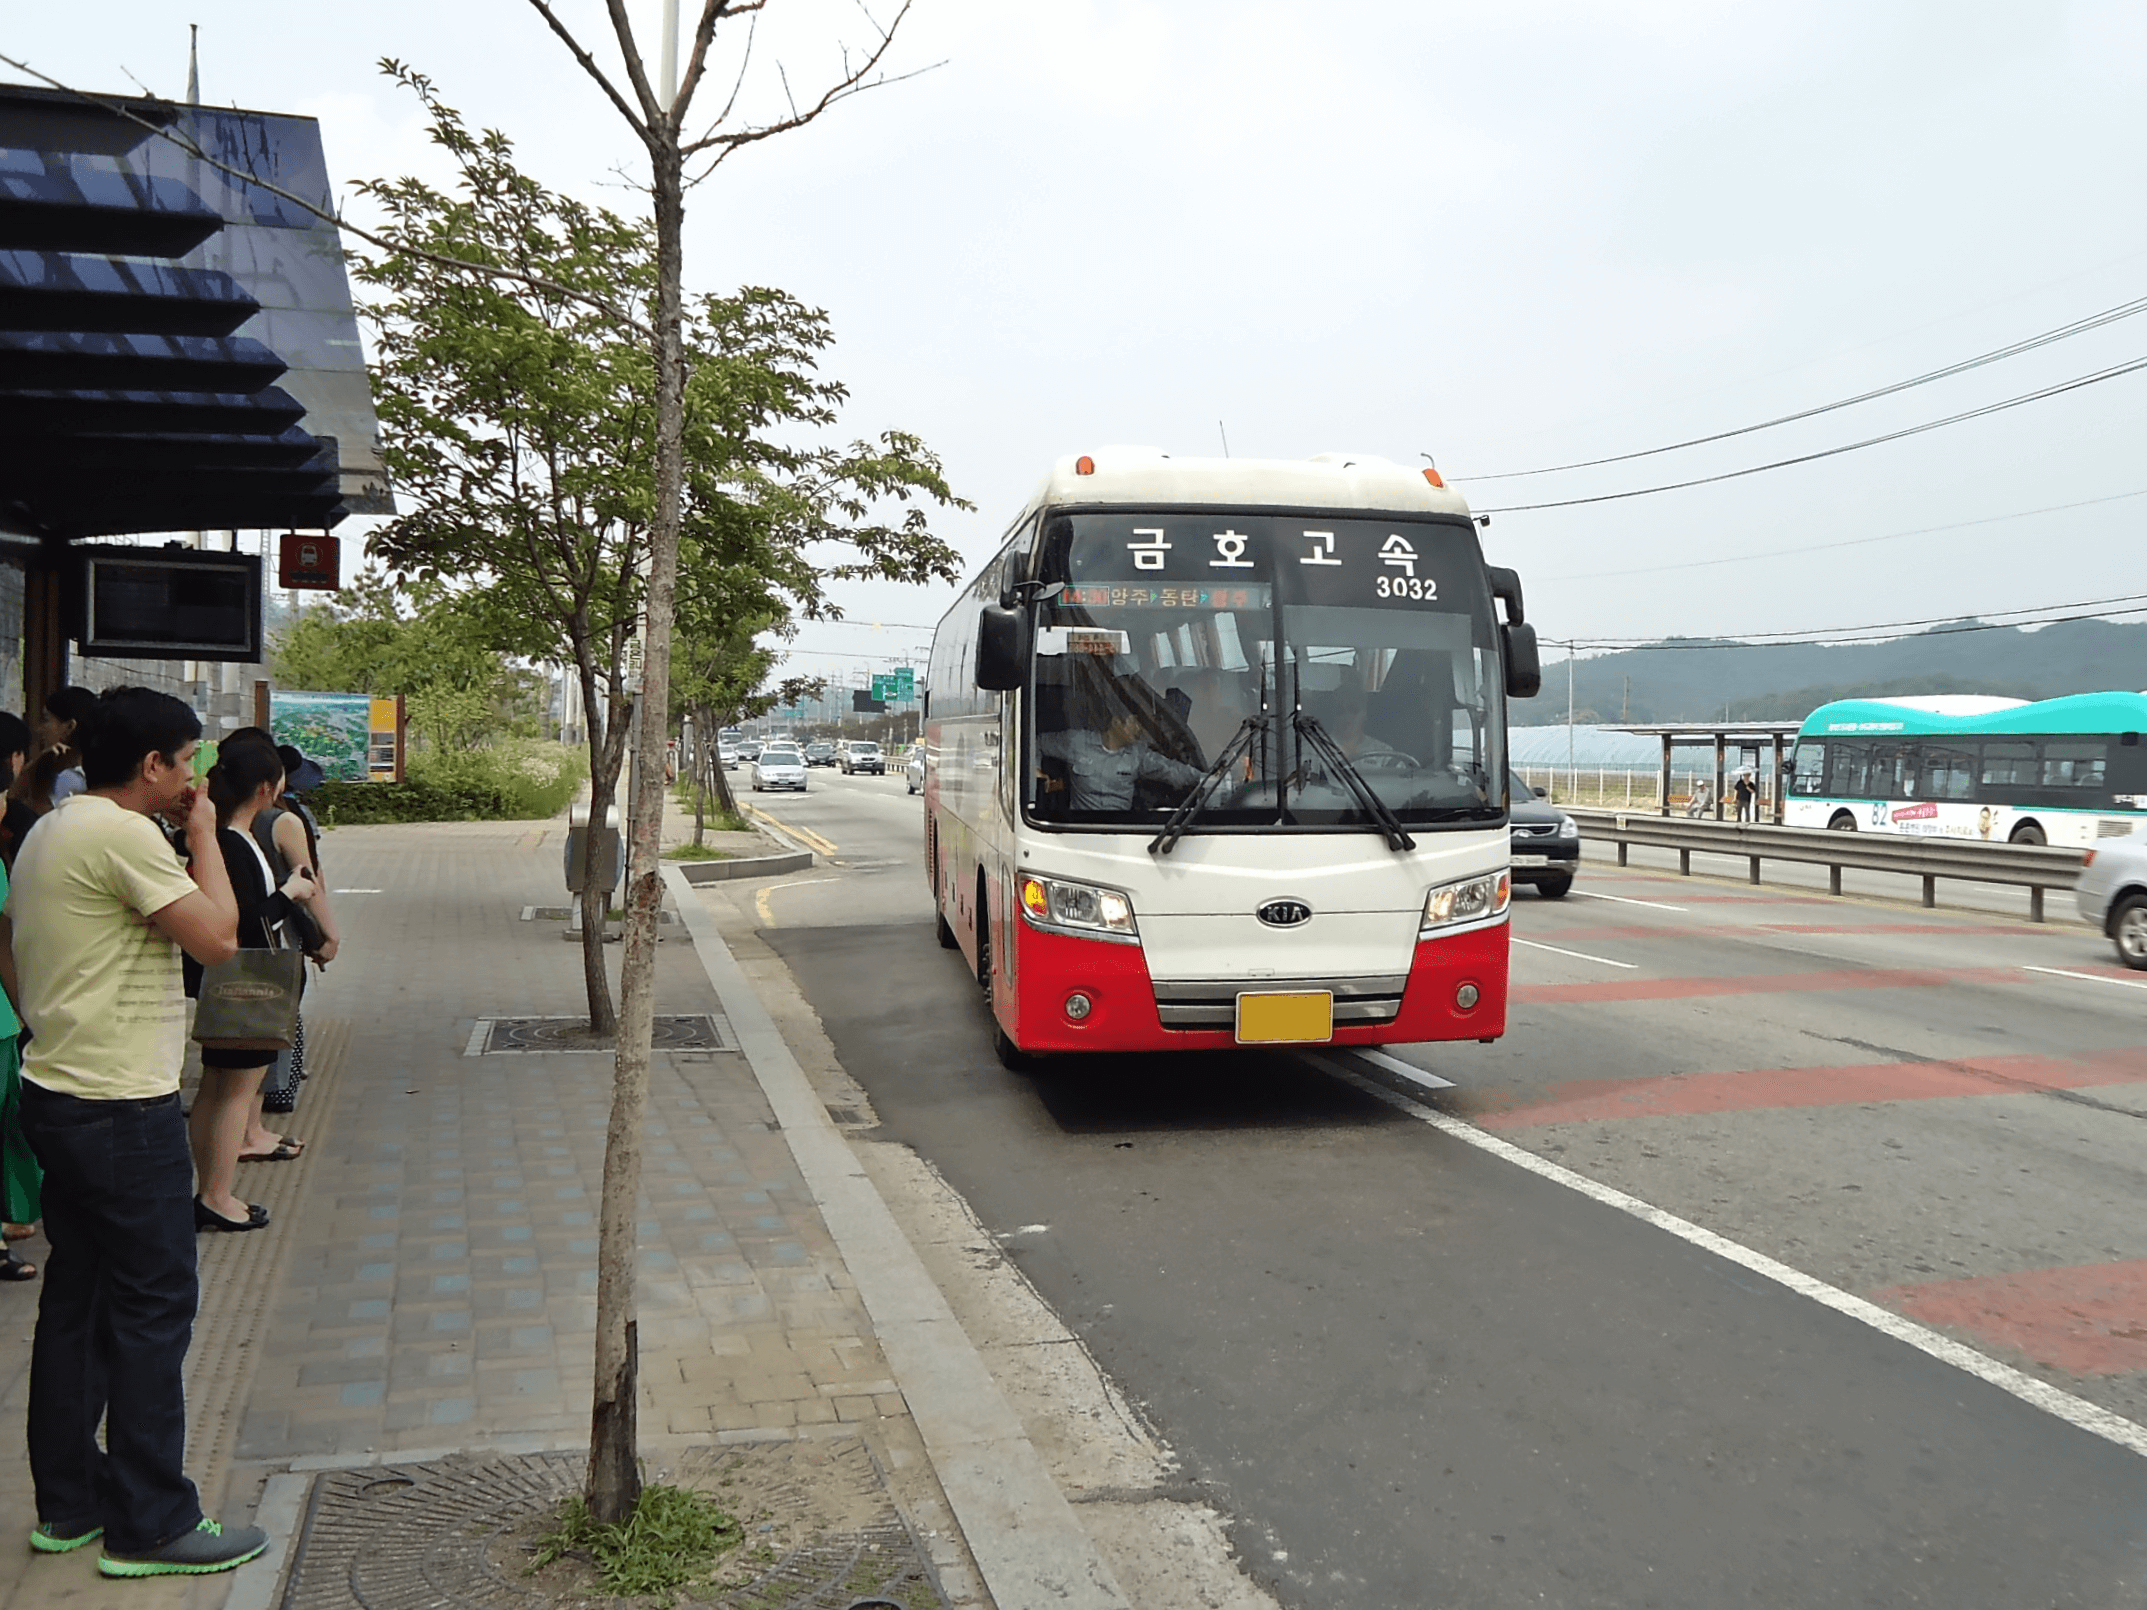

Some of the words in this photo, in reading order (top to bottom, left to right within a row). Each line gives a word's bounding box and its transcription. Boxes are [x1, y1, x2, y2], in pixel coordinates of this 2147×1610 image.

[1160, 588, 1198, 608] 동탄
[1376, 576, 1438, 601] 3032
[1872, 803, 1887, 826] 82
[1266, 906, 1303, 921] KIA
